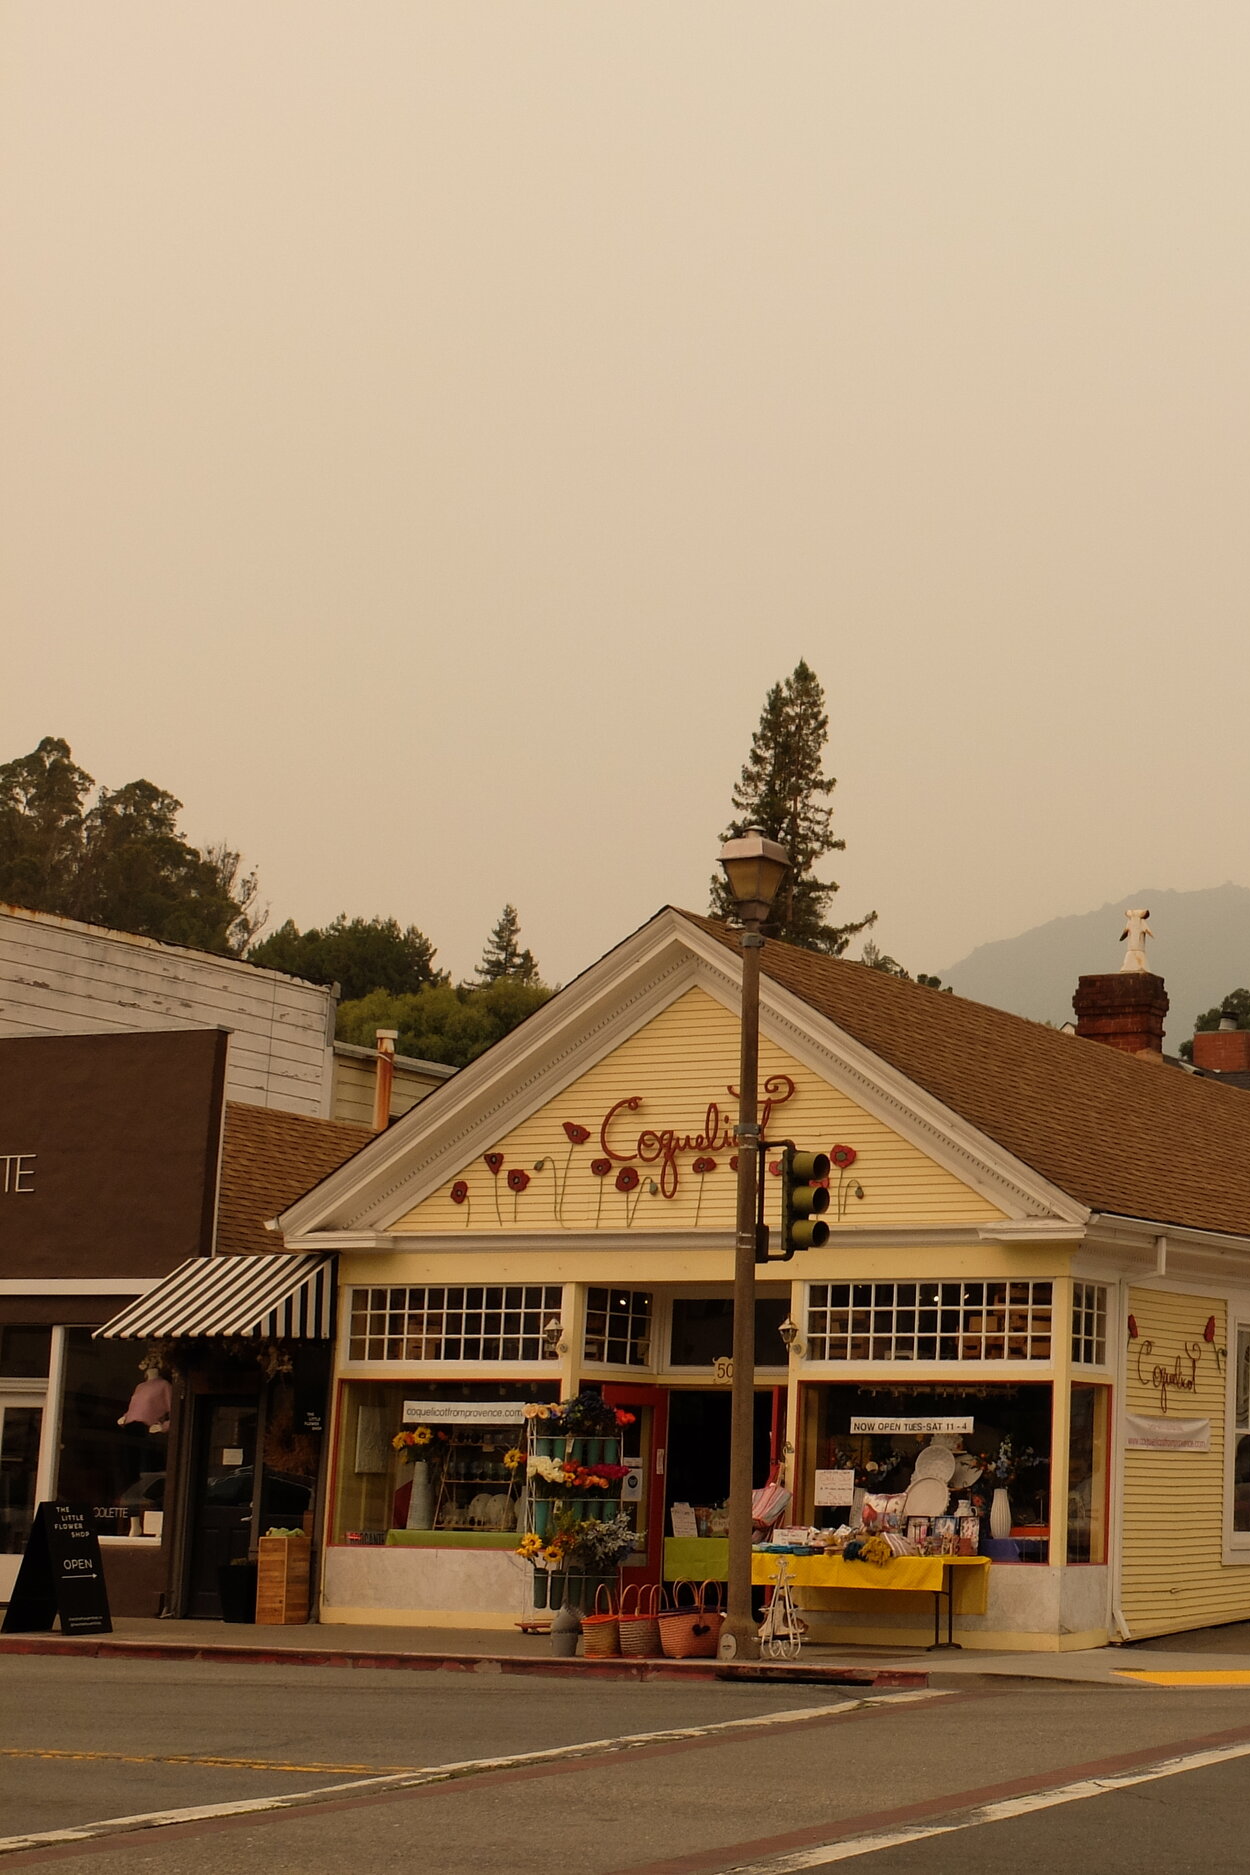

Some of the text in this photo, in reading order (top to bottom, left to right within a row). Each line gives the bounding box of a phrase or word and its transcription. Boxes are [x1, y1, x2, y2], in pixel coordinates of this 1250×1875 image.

[601, 1075, 795, 1199] Coquelit
[853, 1422, 875, 1431] NOW
[878, 1422, 901, 1431] OPEN
[904, 1422, 943, 1431] TUES-SAT
[946, 1422, 954, 1431] 11
[962, 1422, 967, 1430] 4
[63, 1558, 93, 1570] OPEN
